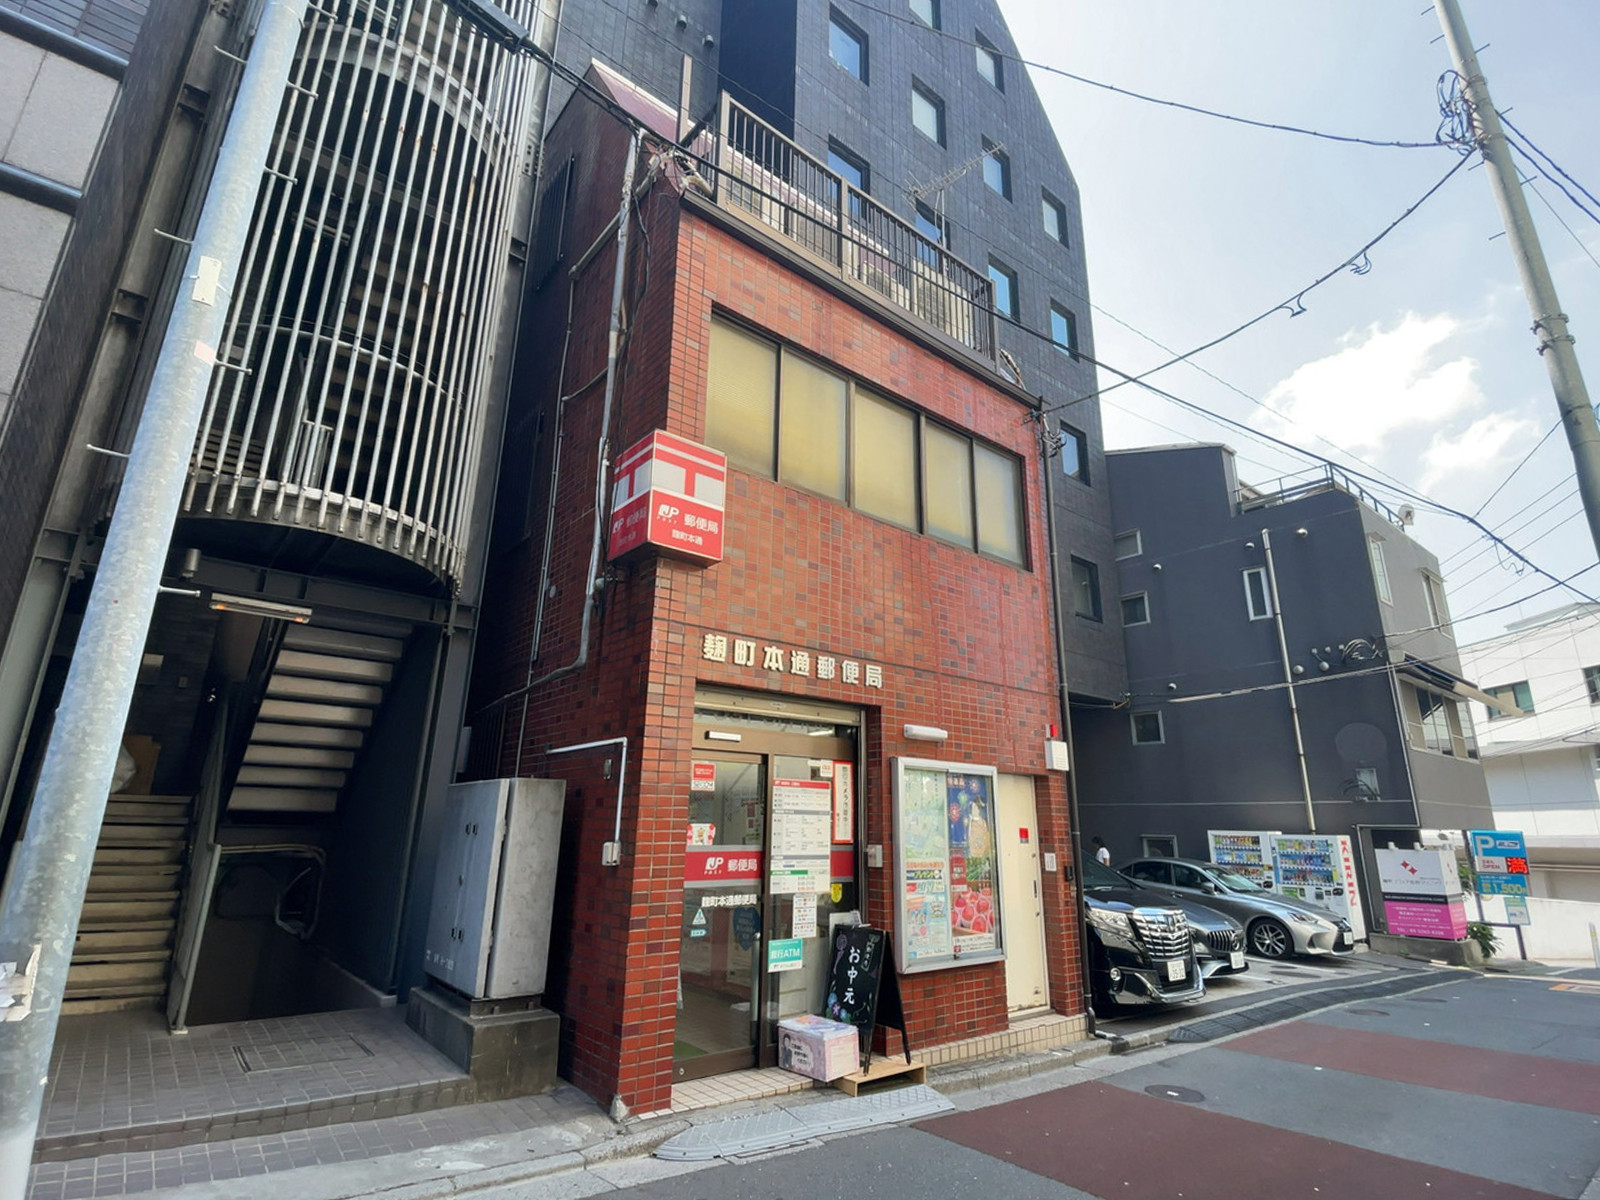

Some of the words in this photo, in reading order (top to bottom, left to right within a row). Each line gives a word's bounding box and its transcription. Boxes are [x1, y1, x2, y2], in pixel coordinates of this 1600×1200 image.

[684, 514, 719, 534] 郵便局
[703, 633, 884, 689] 麹町本通郵便局
[727, 858, 758, 872] 郵便局
[1507, 857, 1527, 873] 満
[842, 946, 861, 1005] お中元
